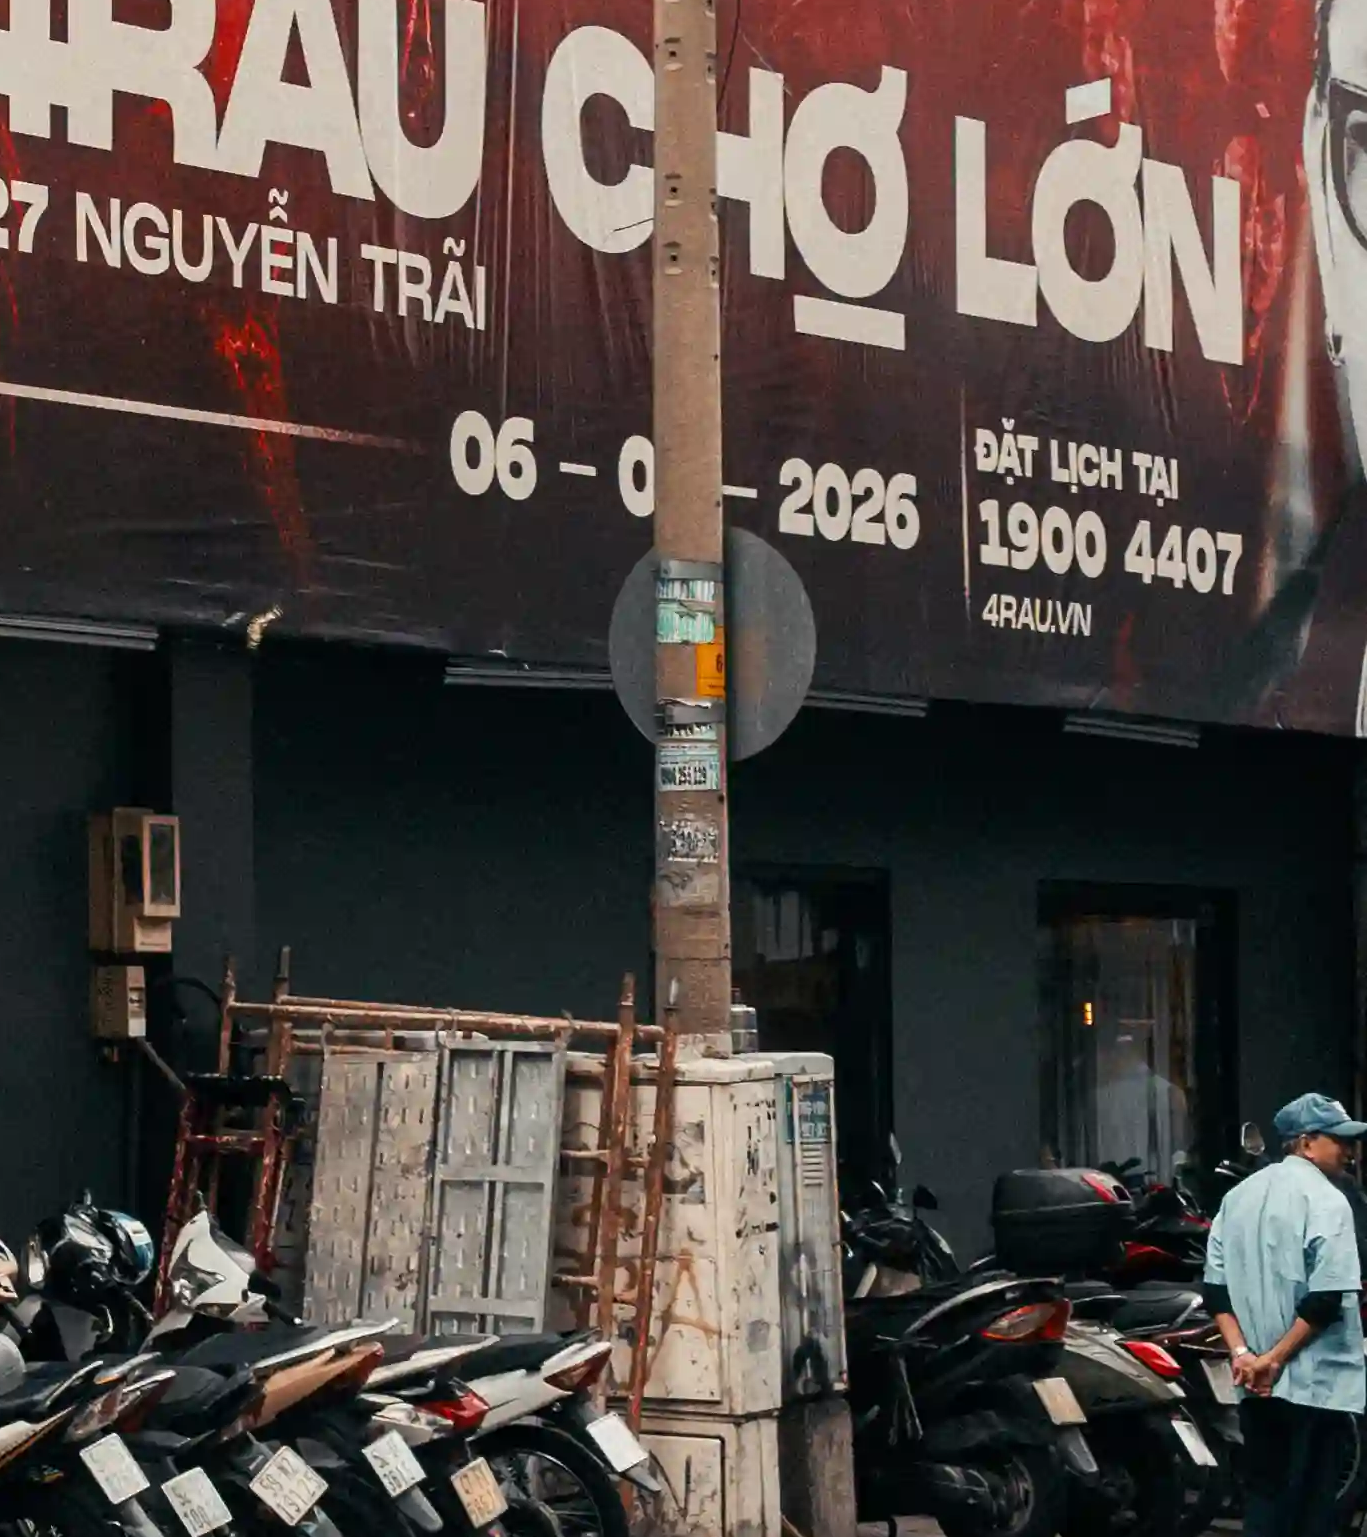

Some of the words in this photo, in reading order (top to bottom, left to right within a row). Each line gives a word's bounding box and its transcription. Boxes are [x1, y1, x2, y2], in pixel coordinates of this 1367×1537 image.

[76, 187, 338, 306] NGUYỄN
[361, 237, 486, 331] TRÃI
[955, 77, 1245, 367] LỚN
[450, 410, 538, 501] 06
[779, 456, 920, 551] 2026
[974, 417, 1040, 485] ĐẶT
[1050, 438, 1123, 494] LỊCH
[1132, 450, 1179, 507] TẠI
[978, 499, 1107, 578] 1900
[1124, 519, 1244, 596] 4407
[981, 593, 1093, 637] 4RAU.VN
